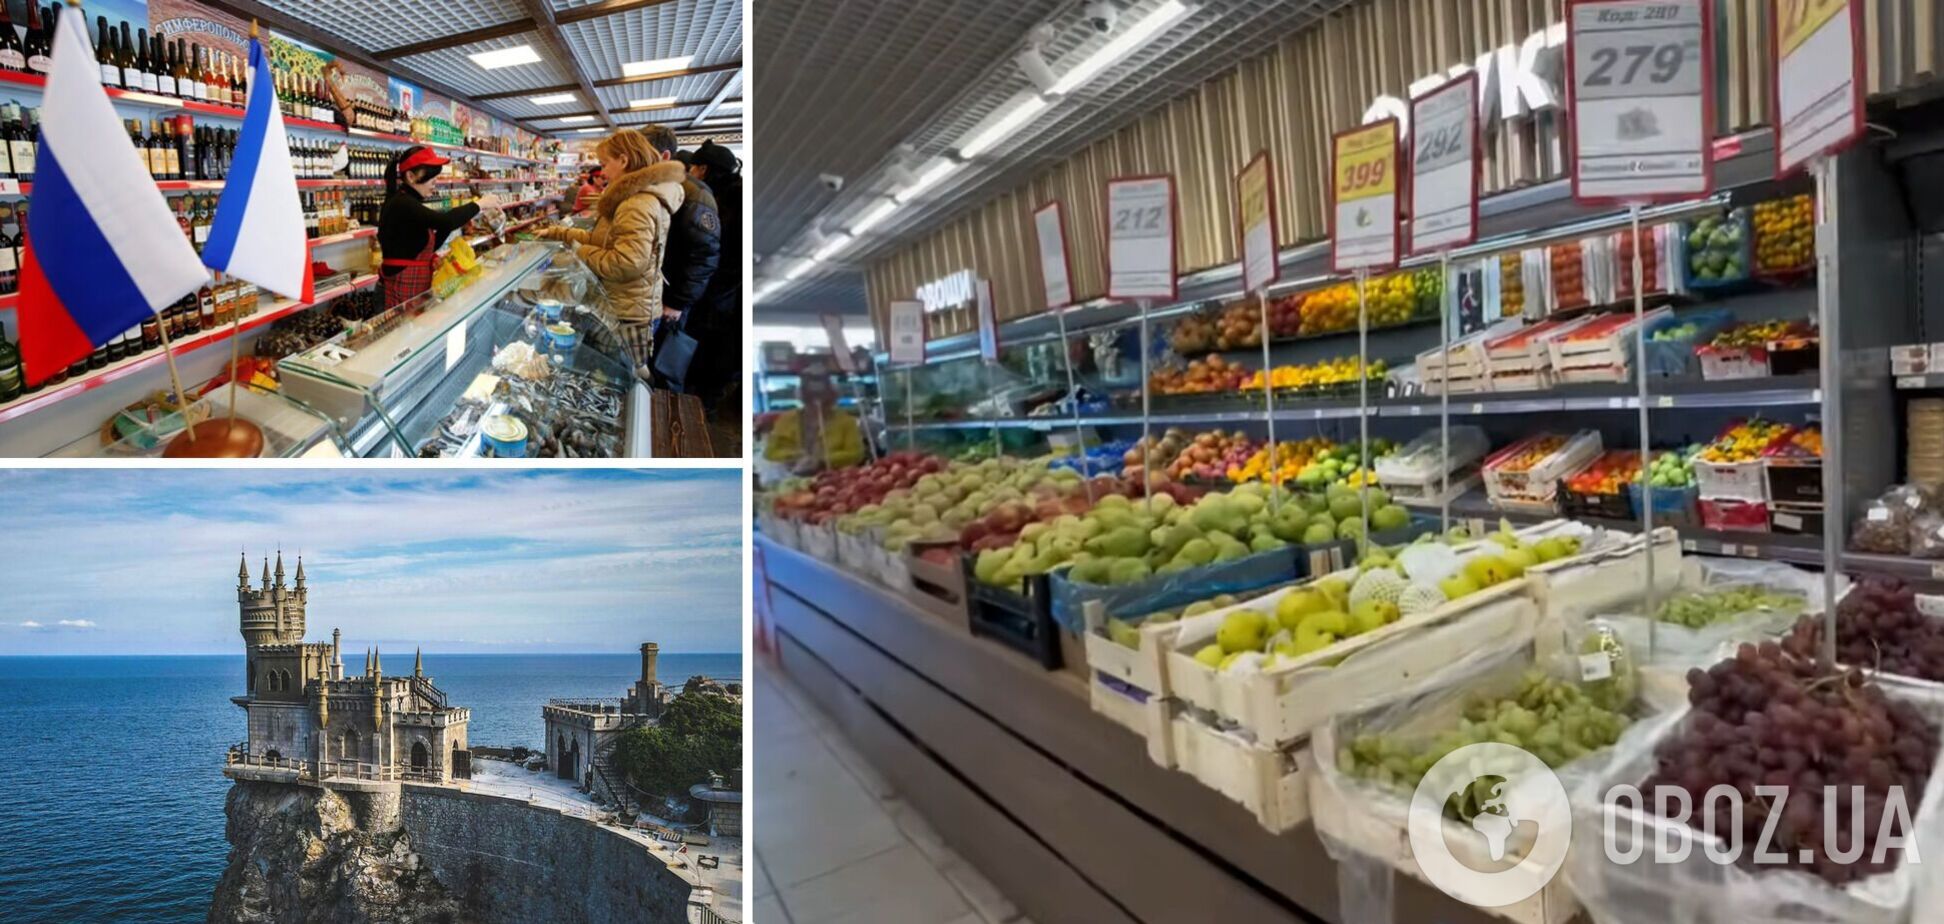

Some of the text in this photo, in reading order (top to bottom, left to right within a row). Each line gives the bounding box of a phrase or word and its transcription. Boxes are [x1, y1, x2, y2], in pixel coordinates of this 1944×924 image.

[1583, 43, 1684, 87] 279
[1416, 119, 1463, 165] 292
[1341, 158, 1386, 192] 399
[1116, 206, 1163, 230] 212
